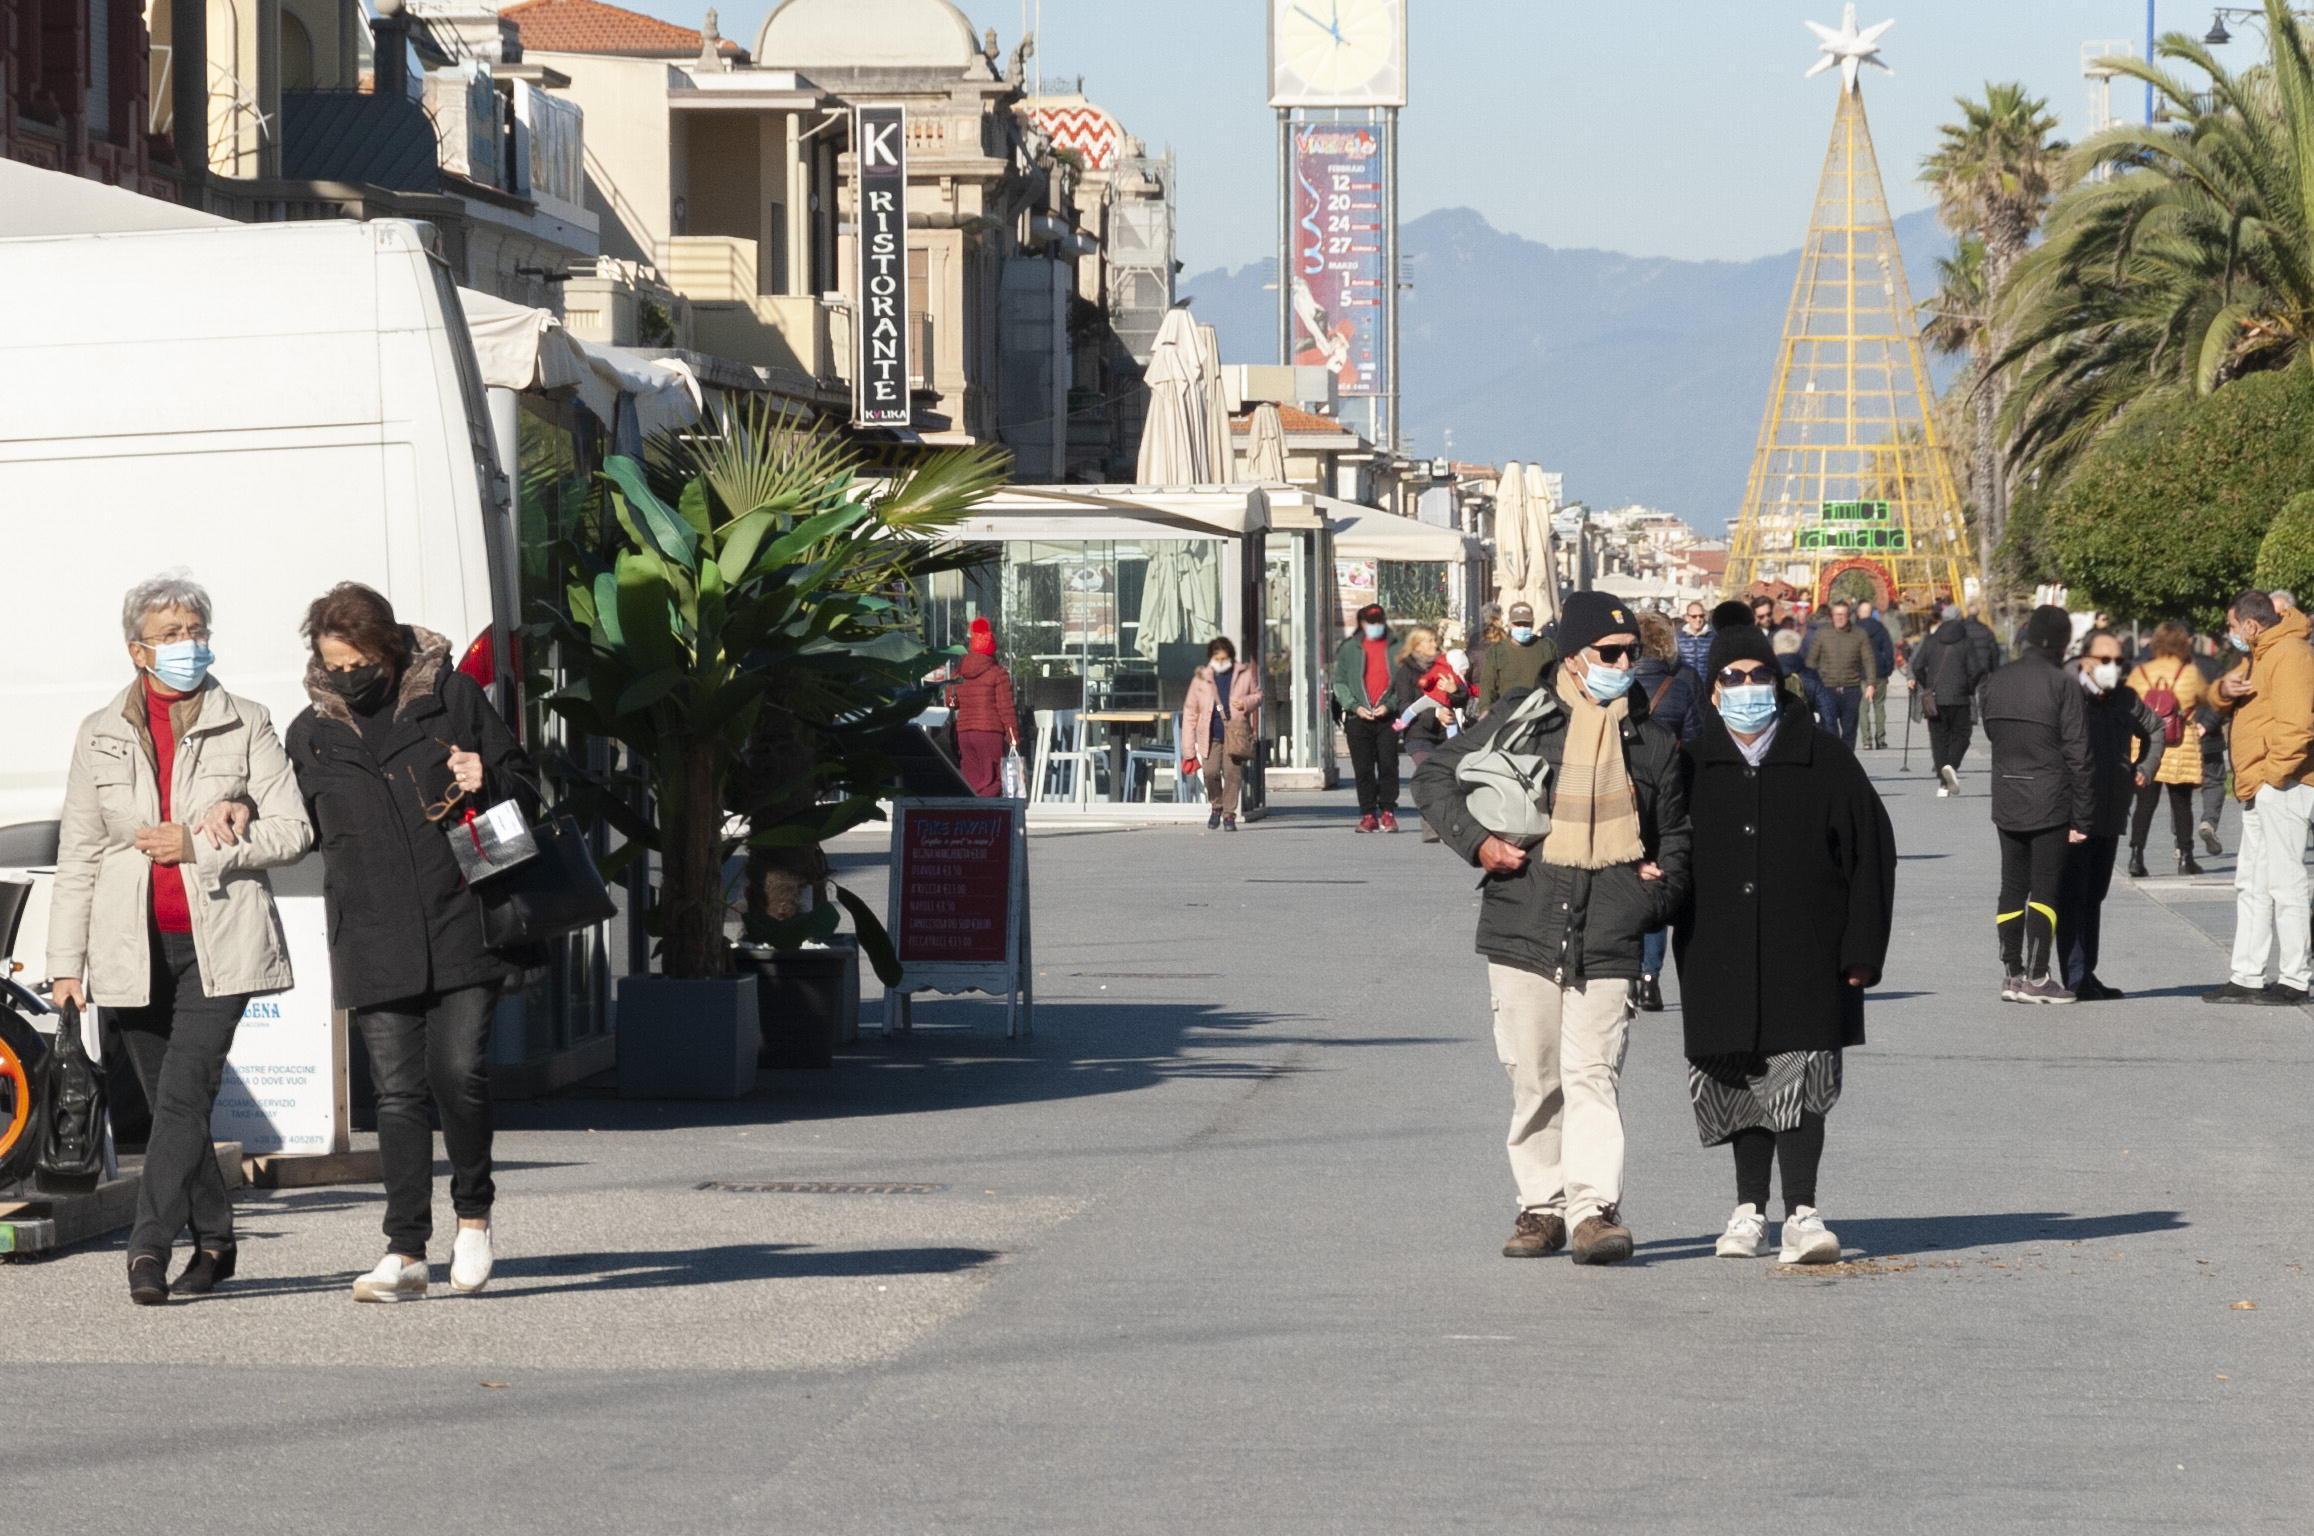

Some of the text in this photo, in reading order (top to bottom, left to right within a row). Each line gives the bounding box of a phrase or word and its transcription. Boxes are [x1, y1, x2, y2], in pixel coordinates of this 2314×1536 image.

[864, 123, 898, 166] K
[1328, 165, 1365, 173] FEBBRAIO
[1332, 175, 1350, 191] 12
[1328, 194, 1350, 211] 20
[1328, 215, 1350, 232] 24
[1329, 237, 1352, 254] 27
[1328, 261, 1358, 270] MARZO
[1341, 271, 1350, 287] 1
[868, 190, 899, 401] RISTORANTE
[1340, 290, 1352, 307] 5
[865, 409, 907, 420] KYLIKA
[1823, 500, 1889, 521] amica
[1797, 527, 1907, 549] farmacia
[216, 1099, 296, 1107] ACCIAMO SERVIZIO
